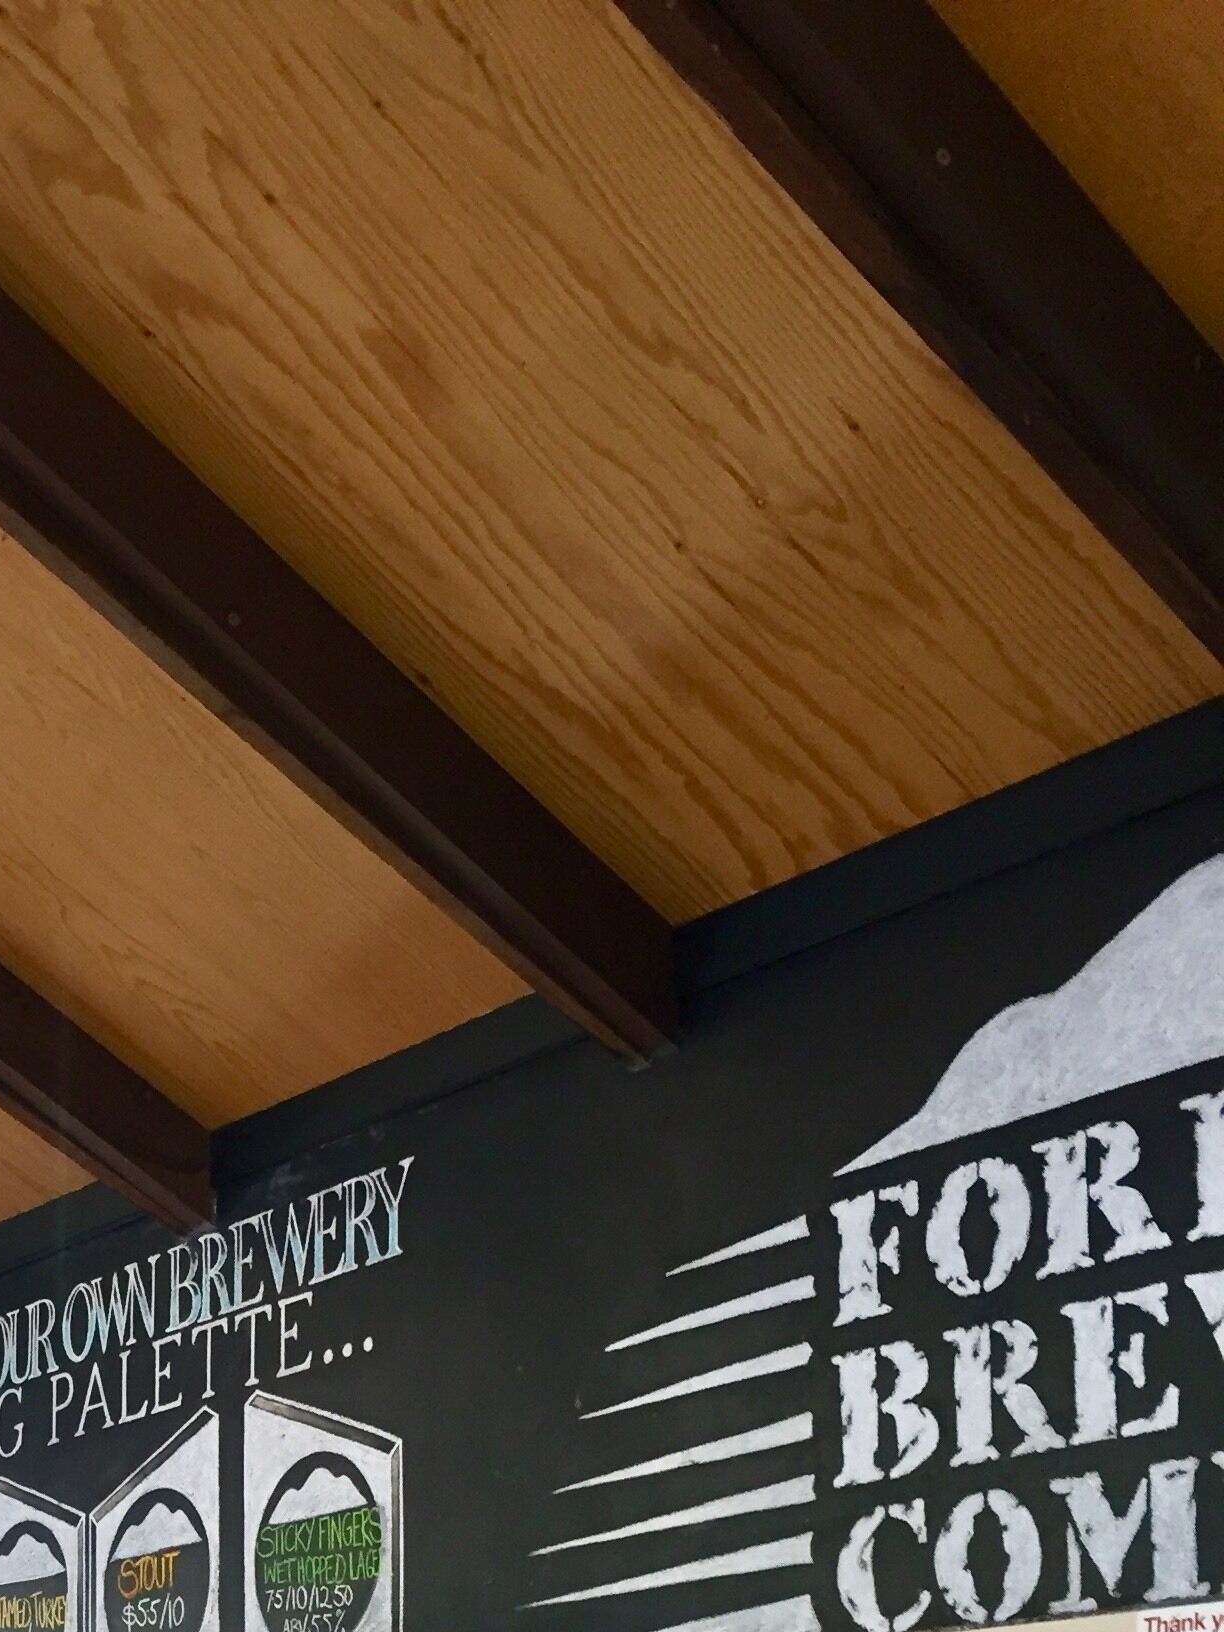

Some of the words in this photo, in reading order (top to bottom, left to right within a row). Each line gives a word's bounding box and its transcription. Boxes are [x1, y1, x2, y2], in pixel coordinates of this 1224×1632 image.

[62, 1254, 161, 1363] OWN
[165, 1155, 414, 1333] BREWERY
[256, 1516, 315, 1558] STICKY
[318, 1507, 382, 1550] FINGERS
[118, 1549, 181, 1599] STOUT
[264, 1557, 296, 1584] WET
[297, 1553, 346, 1585] HOPPED
[349, 1549, 382, 1580] LAGE
